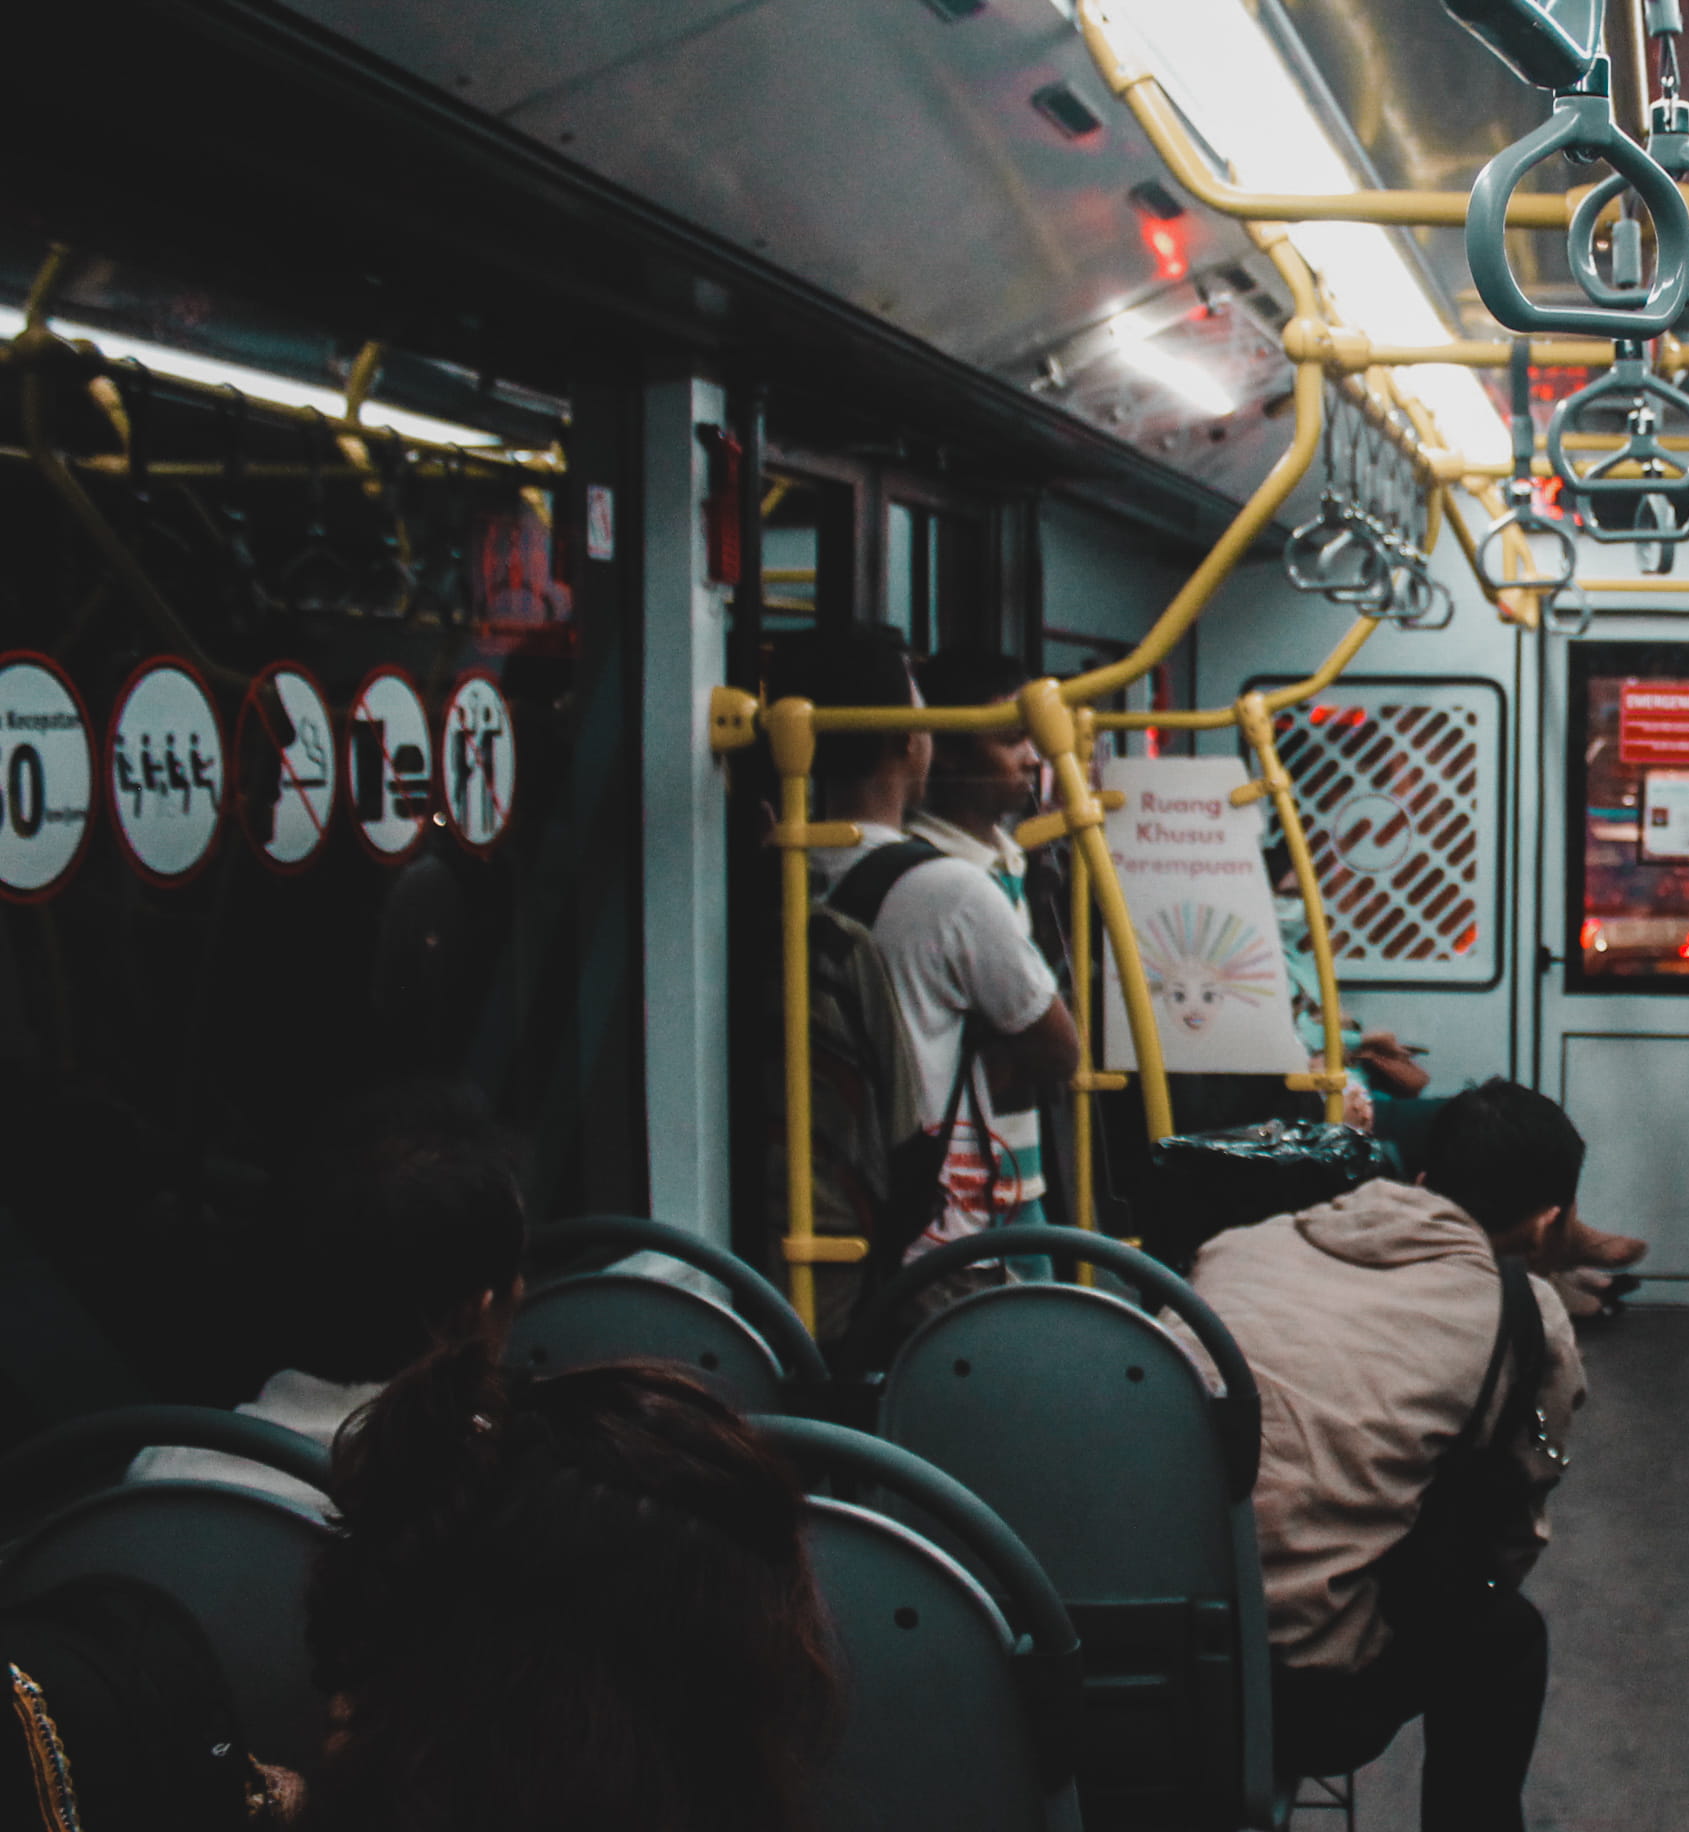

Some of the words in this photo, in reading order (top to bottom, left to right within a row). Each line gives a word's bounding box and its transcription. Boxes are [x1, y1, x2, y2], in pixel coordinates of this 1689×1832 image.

[1140, 792, 1223, 819] Ruang
[1136, 822, 1226, 844] Khusus
[1111, 851, 1254, 878] Perempuan
